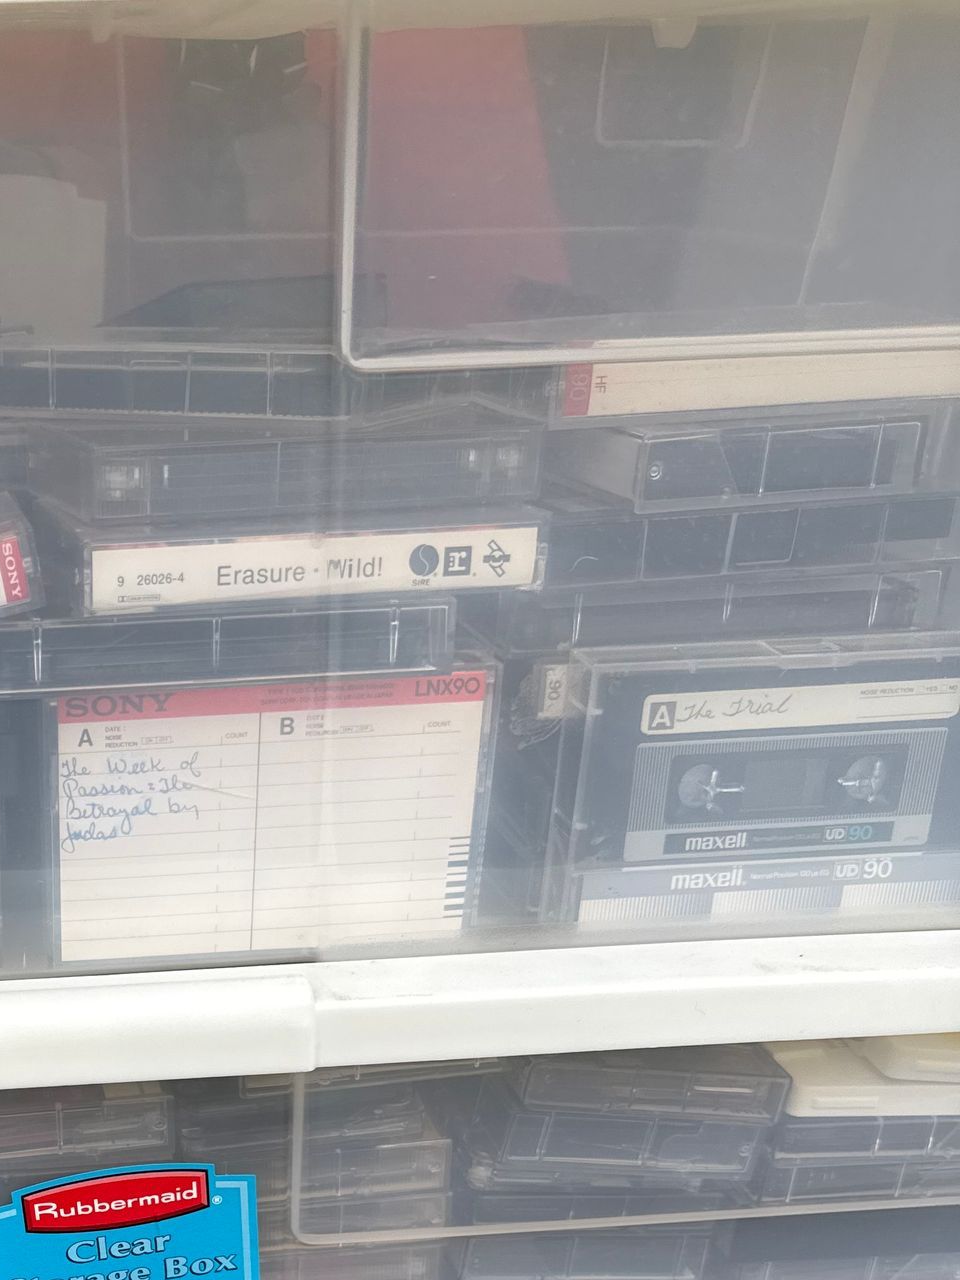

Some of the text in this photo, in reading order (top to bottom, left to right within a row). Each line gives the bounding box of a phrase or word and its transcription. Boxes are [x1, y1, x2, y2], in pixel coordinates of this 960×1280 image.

[594, 375, 608, 394] HF
[1, 542, 23, 598] SONY
[117, 556, 383, 587] 9 26026-4 Erasure Wild!
[411, 578, 430, 586] SIRE
[414, 677, 480, 697] LNX90
[64, 692, 174, 718] SONY
[651, 704, 673, 727] A
[676, 693, 793, 722] The Trial
[77, 728, 93, 747] A
[279, 716, 295, 736] B
[60, 751, 201, 778] The Week of
[62, 776, 143, 801] Passion
[65, 797, 200, 835] Betrayal by
[685, 831, 747, 850] maxell
[824, 828, 846, 841] UD
[849, 825, 873, 841] 90
[670, 866, 745, 890] maxell
[835, 863, 859, 879] UD
[863, 859, 893, 879] 90
[33, 1181, 198, 1221] Rubbermaid
[66, 1234, 171, 1263] Clear
[164, 1254, 238, 1280] Box
